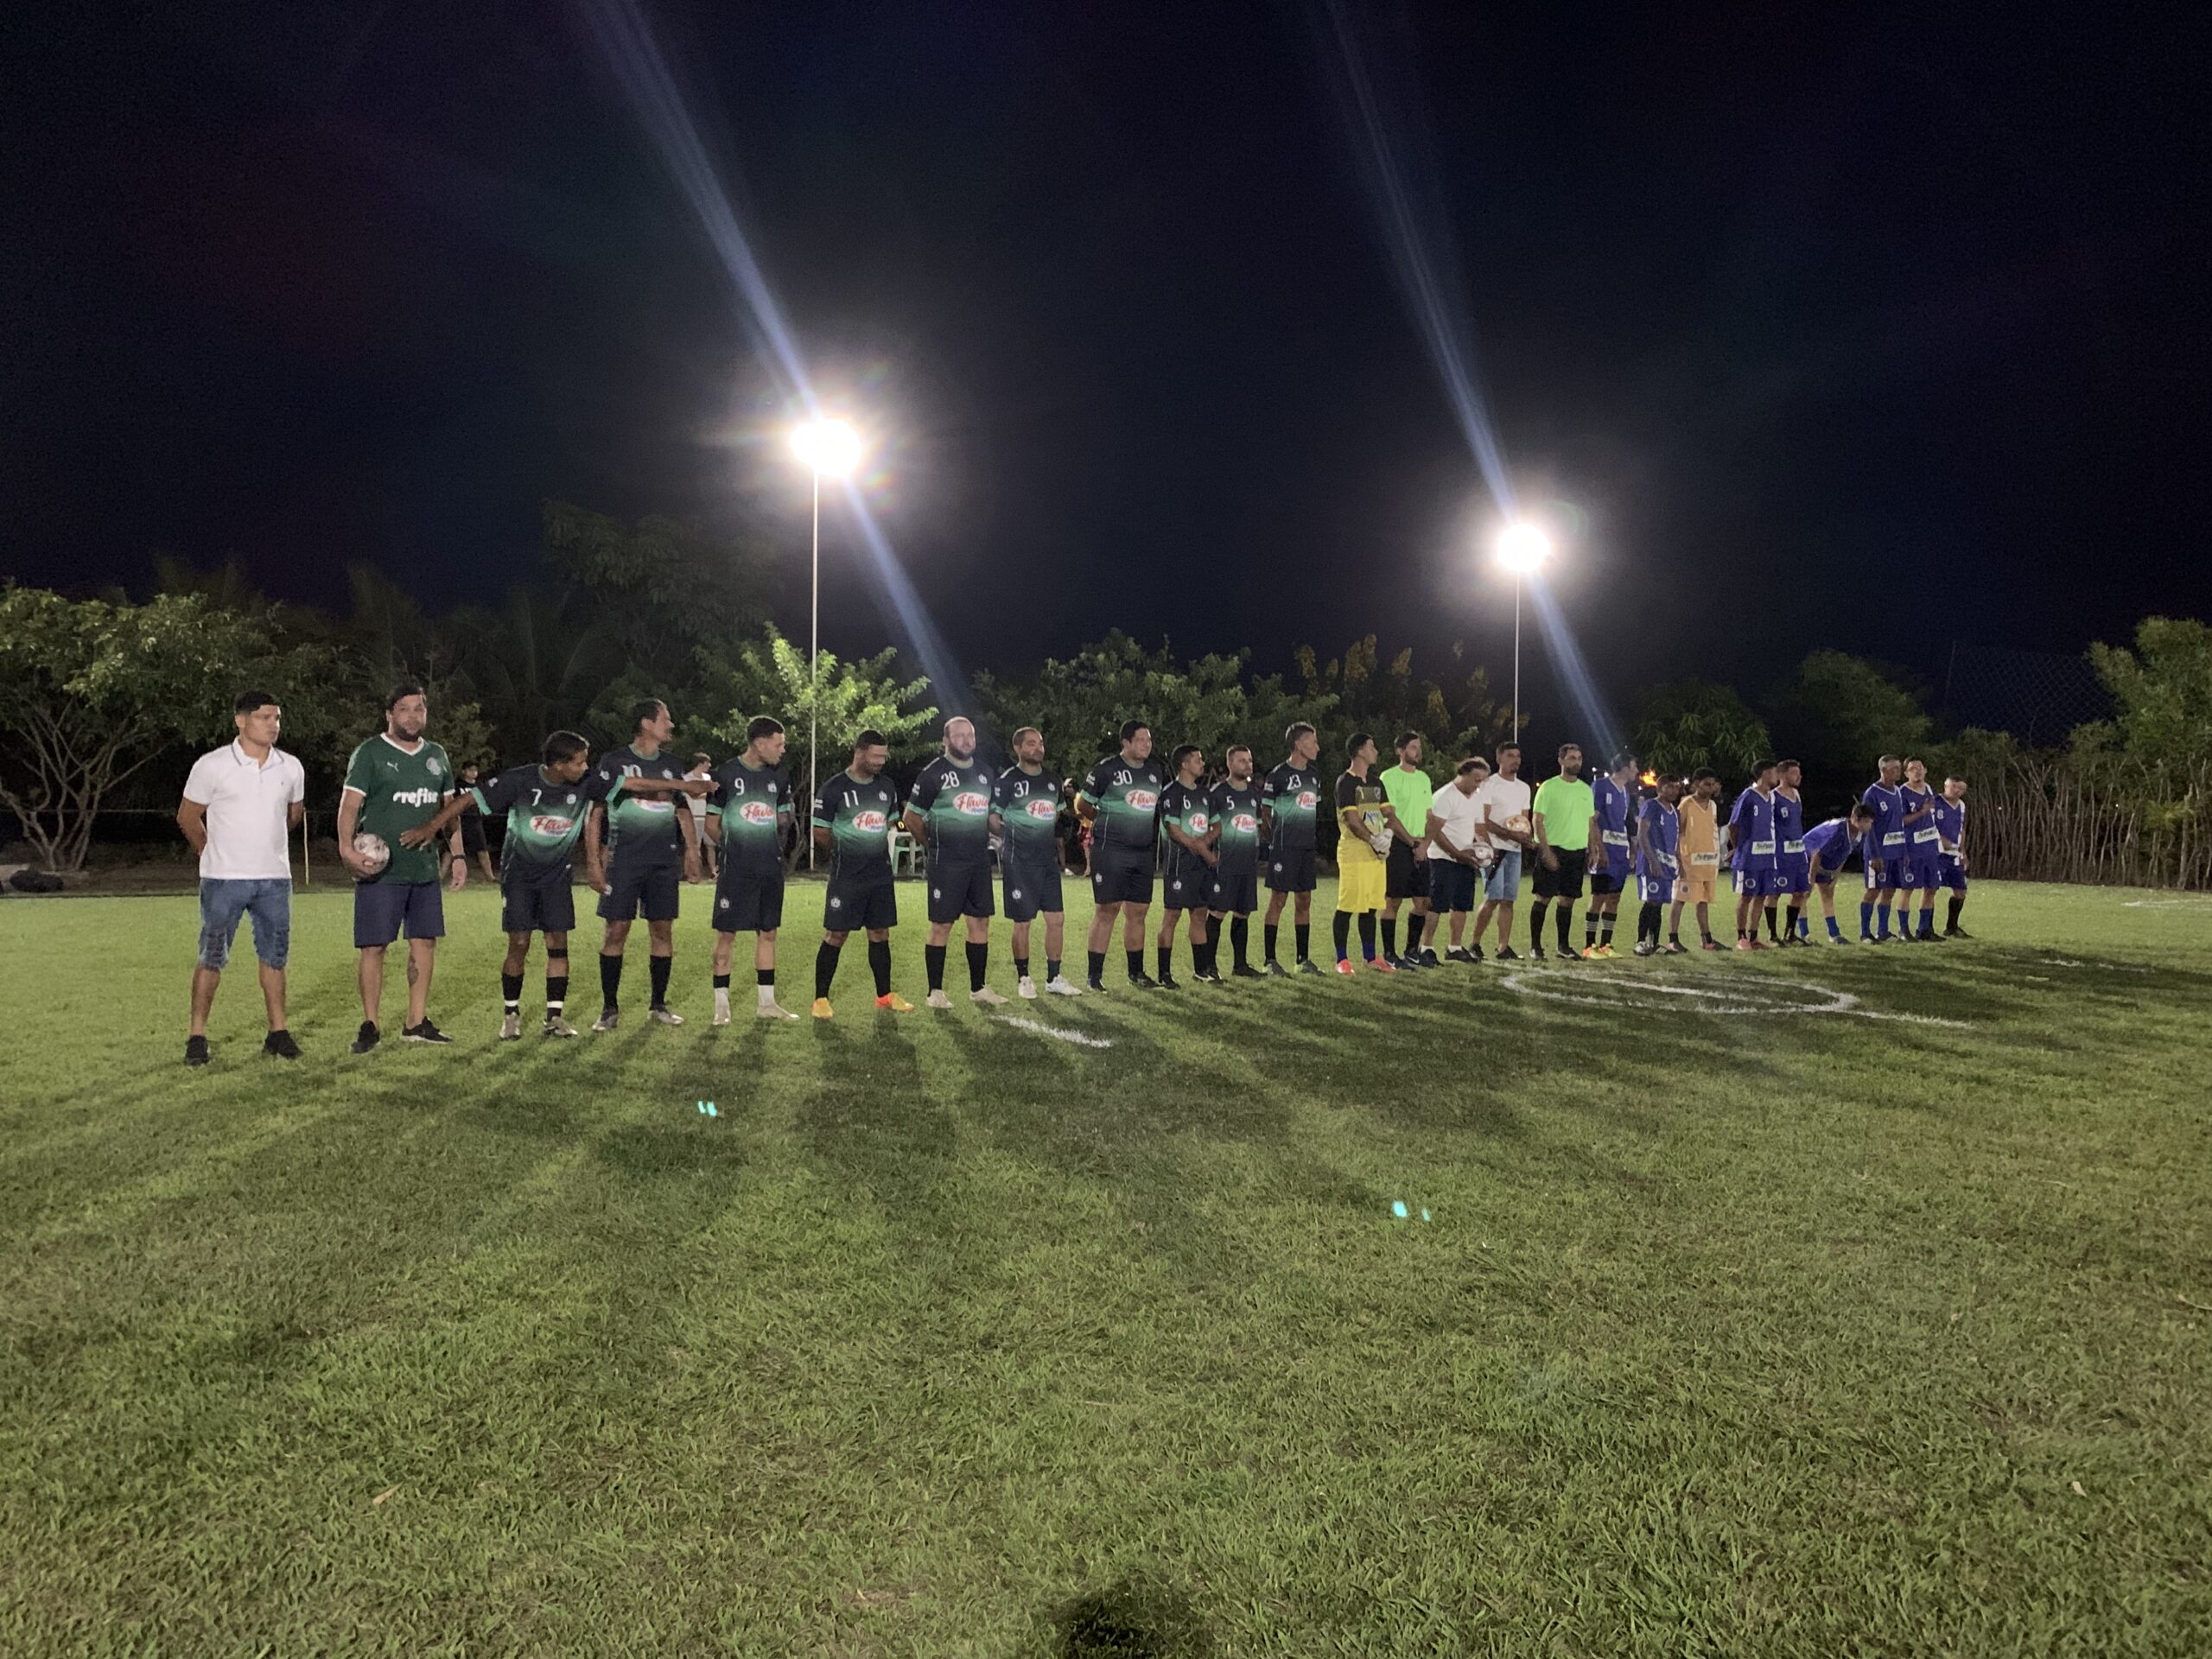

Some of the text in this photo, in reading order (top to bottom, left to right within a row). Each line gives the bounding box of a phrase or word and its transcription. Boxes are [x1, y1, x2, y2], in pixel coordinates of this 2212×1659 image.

[941, 771, 959, 790] 28
[1113, 770, 1132, 785] 30
[734, 778, 744, 795] 9
[1014, 780, 1029, 798] 37
[531, 788, 542, 806] 7
[843, 790, 859, 808] 11
[1183, 795, 1191, 810] 6
[1227, 795, 1235, 810] 5
